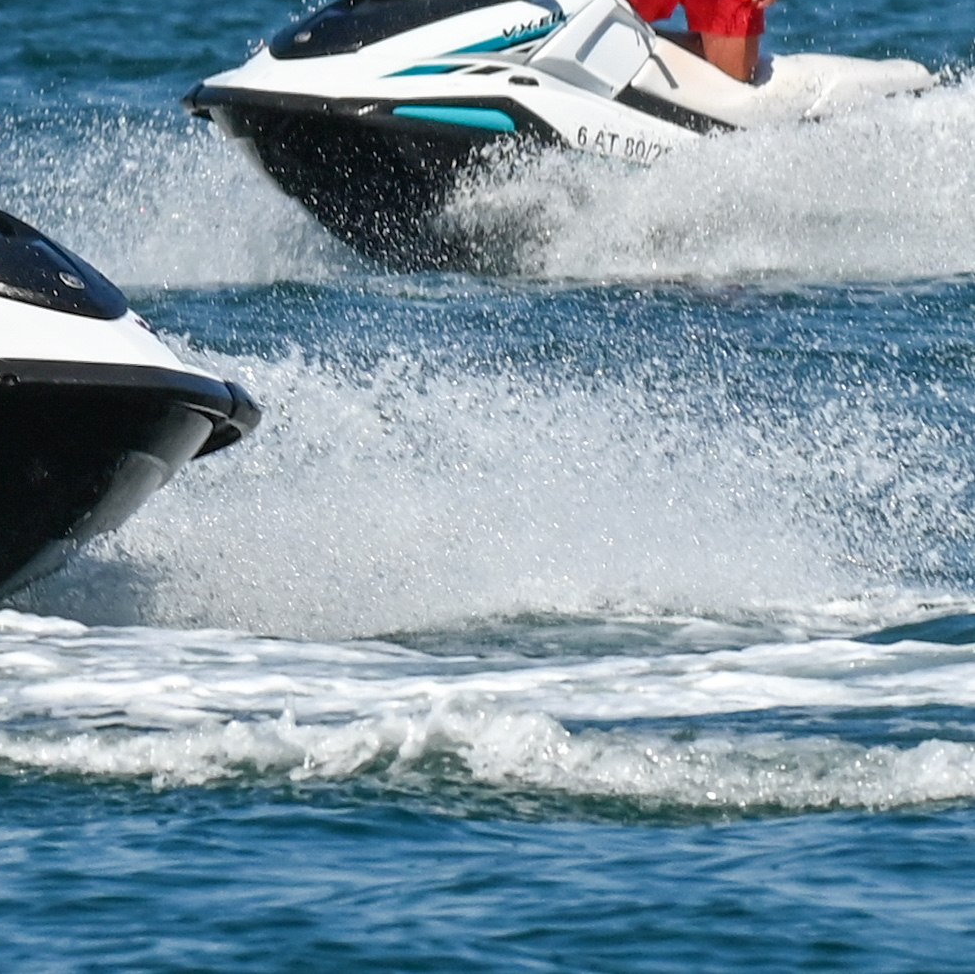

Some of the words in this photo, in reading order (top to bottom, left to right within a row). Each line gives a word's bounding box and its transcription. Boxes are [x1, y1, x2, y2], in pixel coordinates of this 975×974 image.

[577, 126, 587, 147] 6
[595, 130, 619, 154] AT
[624, 137, 672, 161] 80/2
